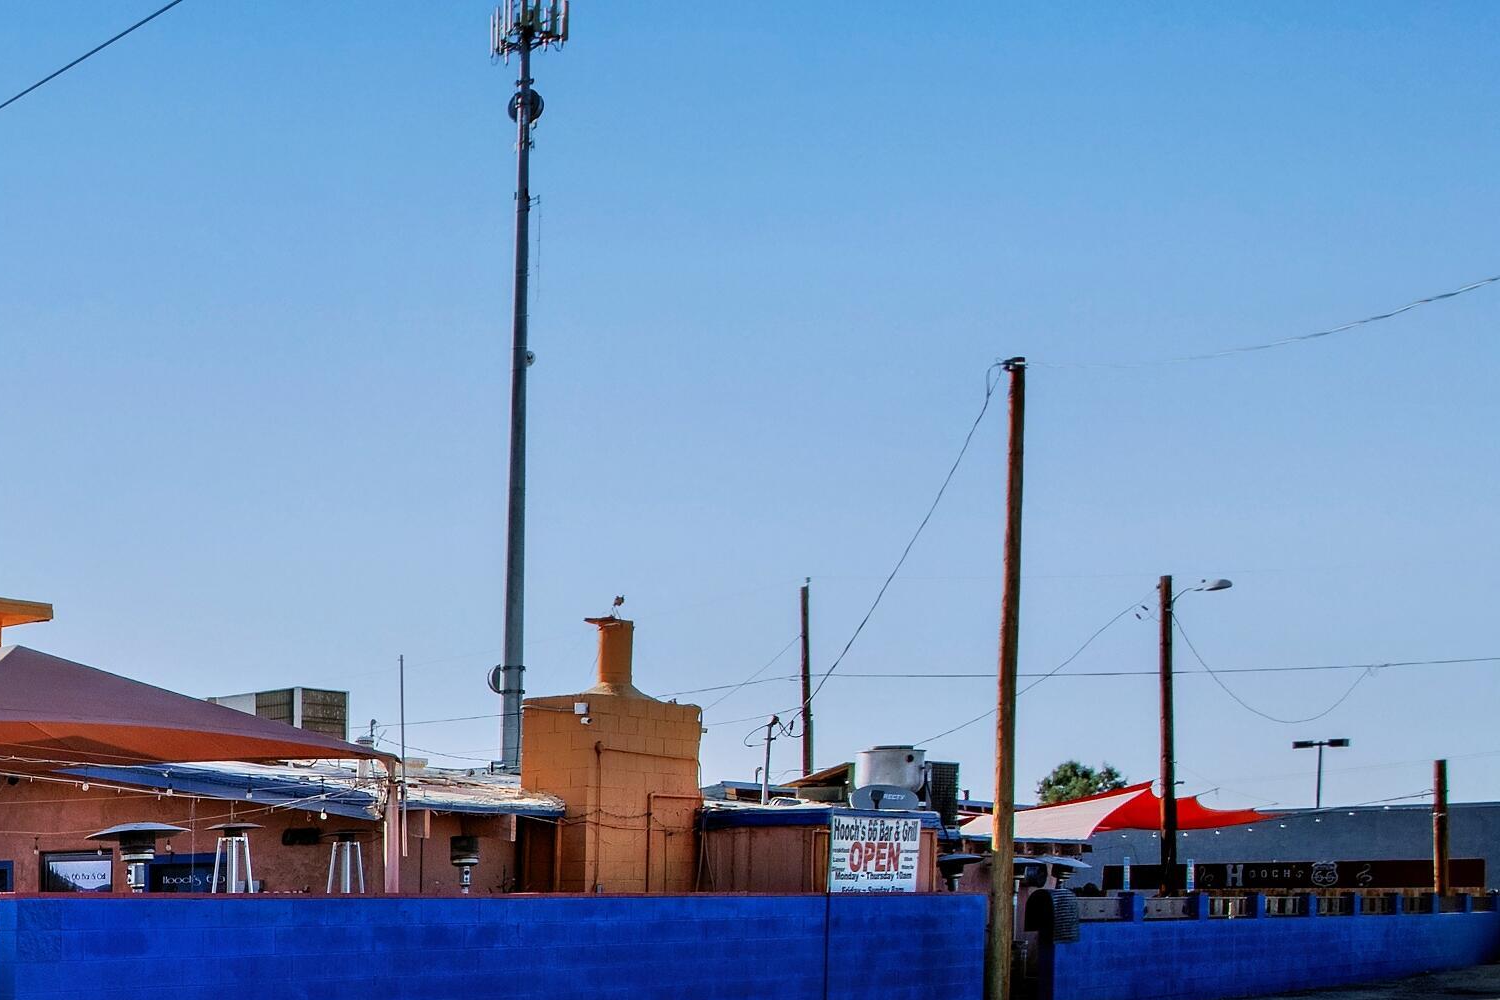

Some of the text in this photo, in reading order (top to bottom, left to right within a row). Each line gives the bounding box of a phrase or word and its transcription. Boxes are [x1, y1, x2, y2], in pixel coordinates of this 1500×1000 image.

[834, 817, 866, 841] Hooch's
[867, 819, 878, 841] 66
[880, 820, 893, 841] Bar
[902, 820, 918, 842] Grill
[849, 841, 901, 872] OPEN
[835, 872, 860, 882] Monday
[866, 872, 895, 882] Thursday
